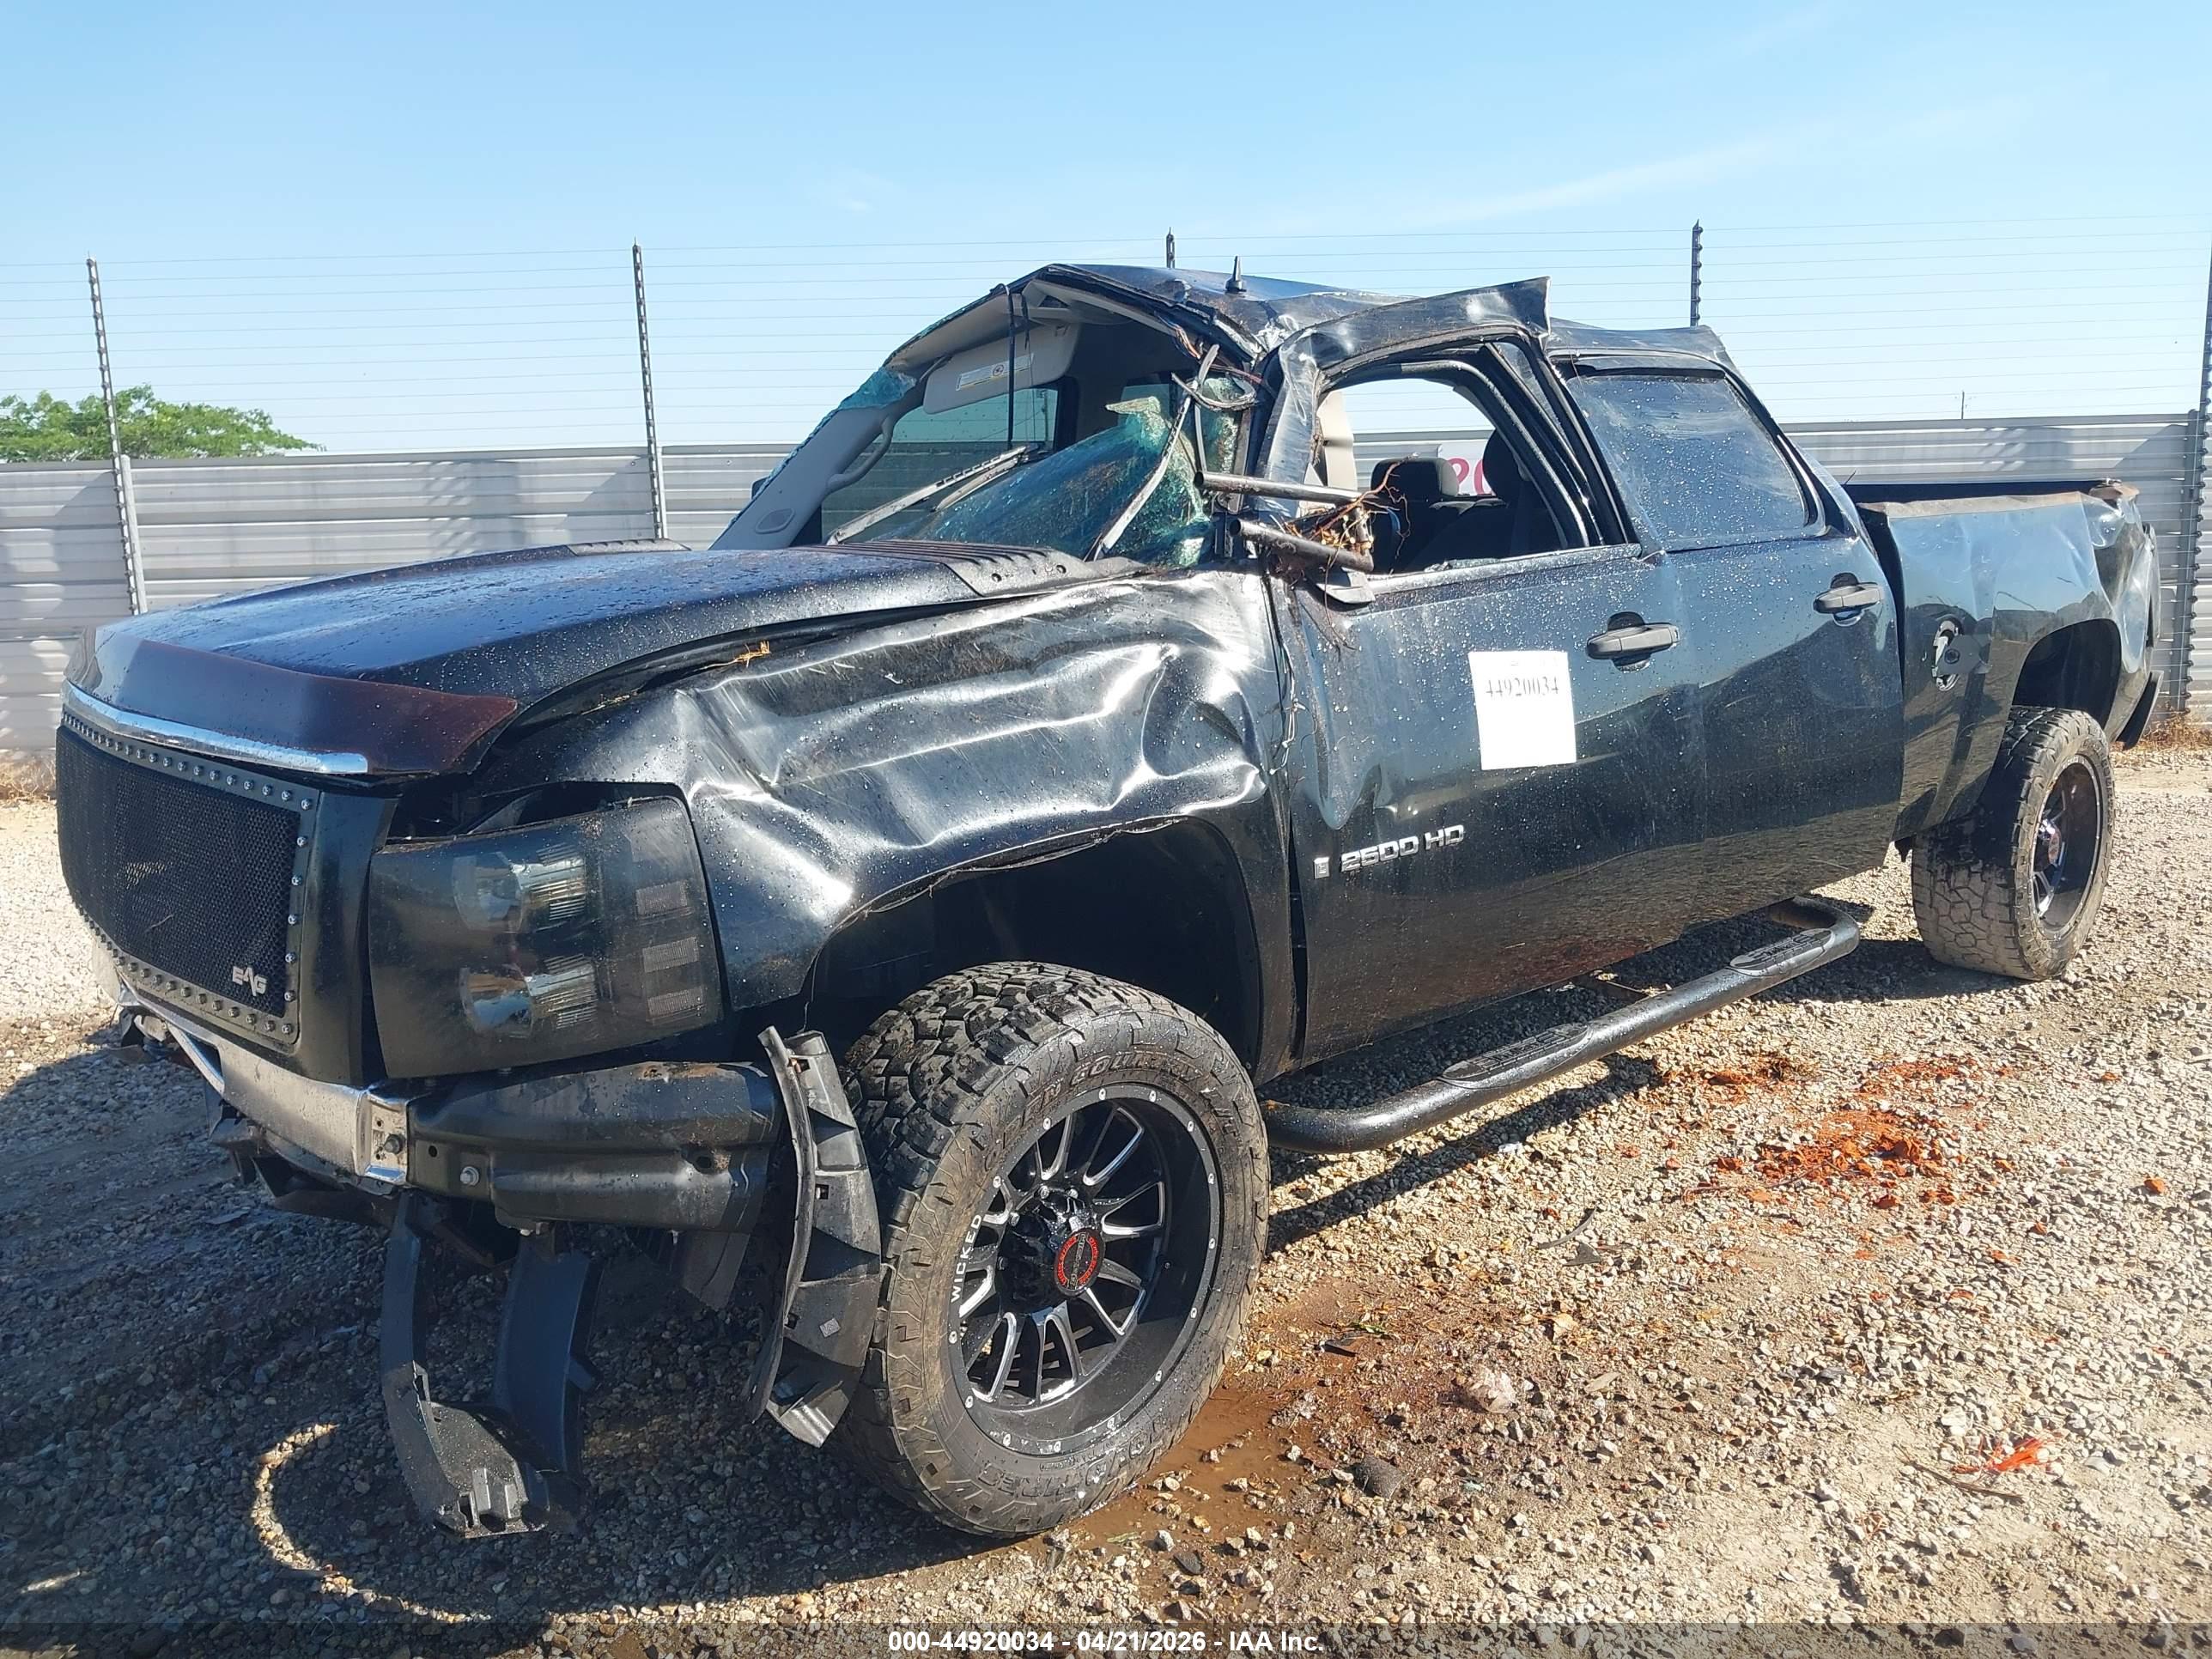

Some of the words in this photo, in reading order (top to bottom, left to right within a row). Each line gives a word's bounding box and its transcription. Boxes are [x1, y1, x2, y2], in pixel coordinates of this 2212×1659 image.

[1486, 675, 1559, 698] 44920034
[1341, 836, 1419, 872] 2500
[1425, 824, 1464, 850] HD
[232, 966, 268, 996] EAG
[951, 1214, 982, 1304] WICKED
